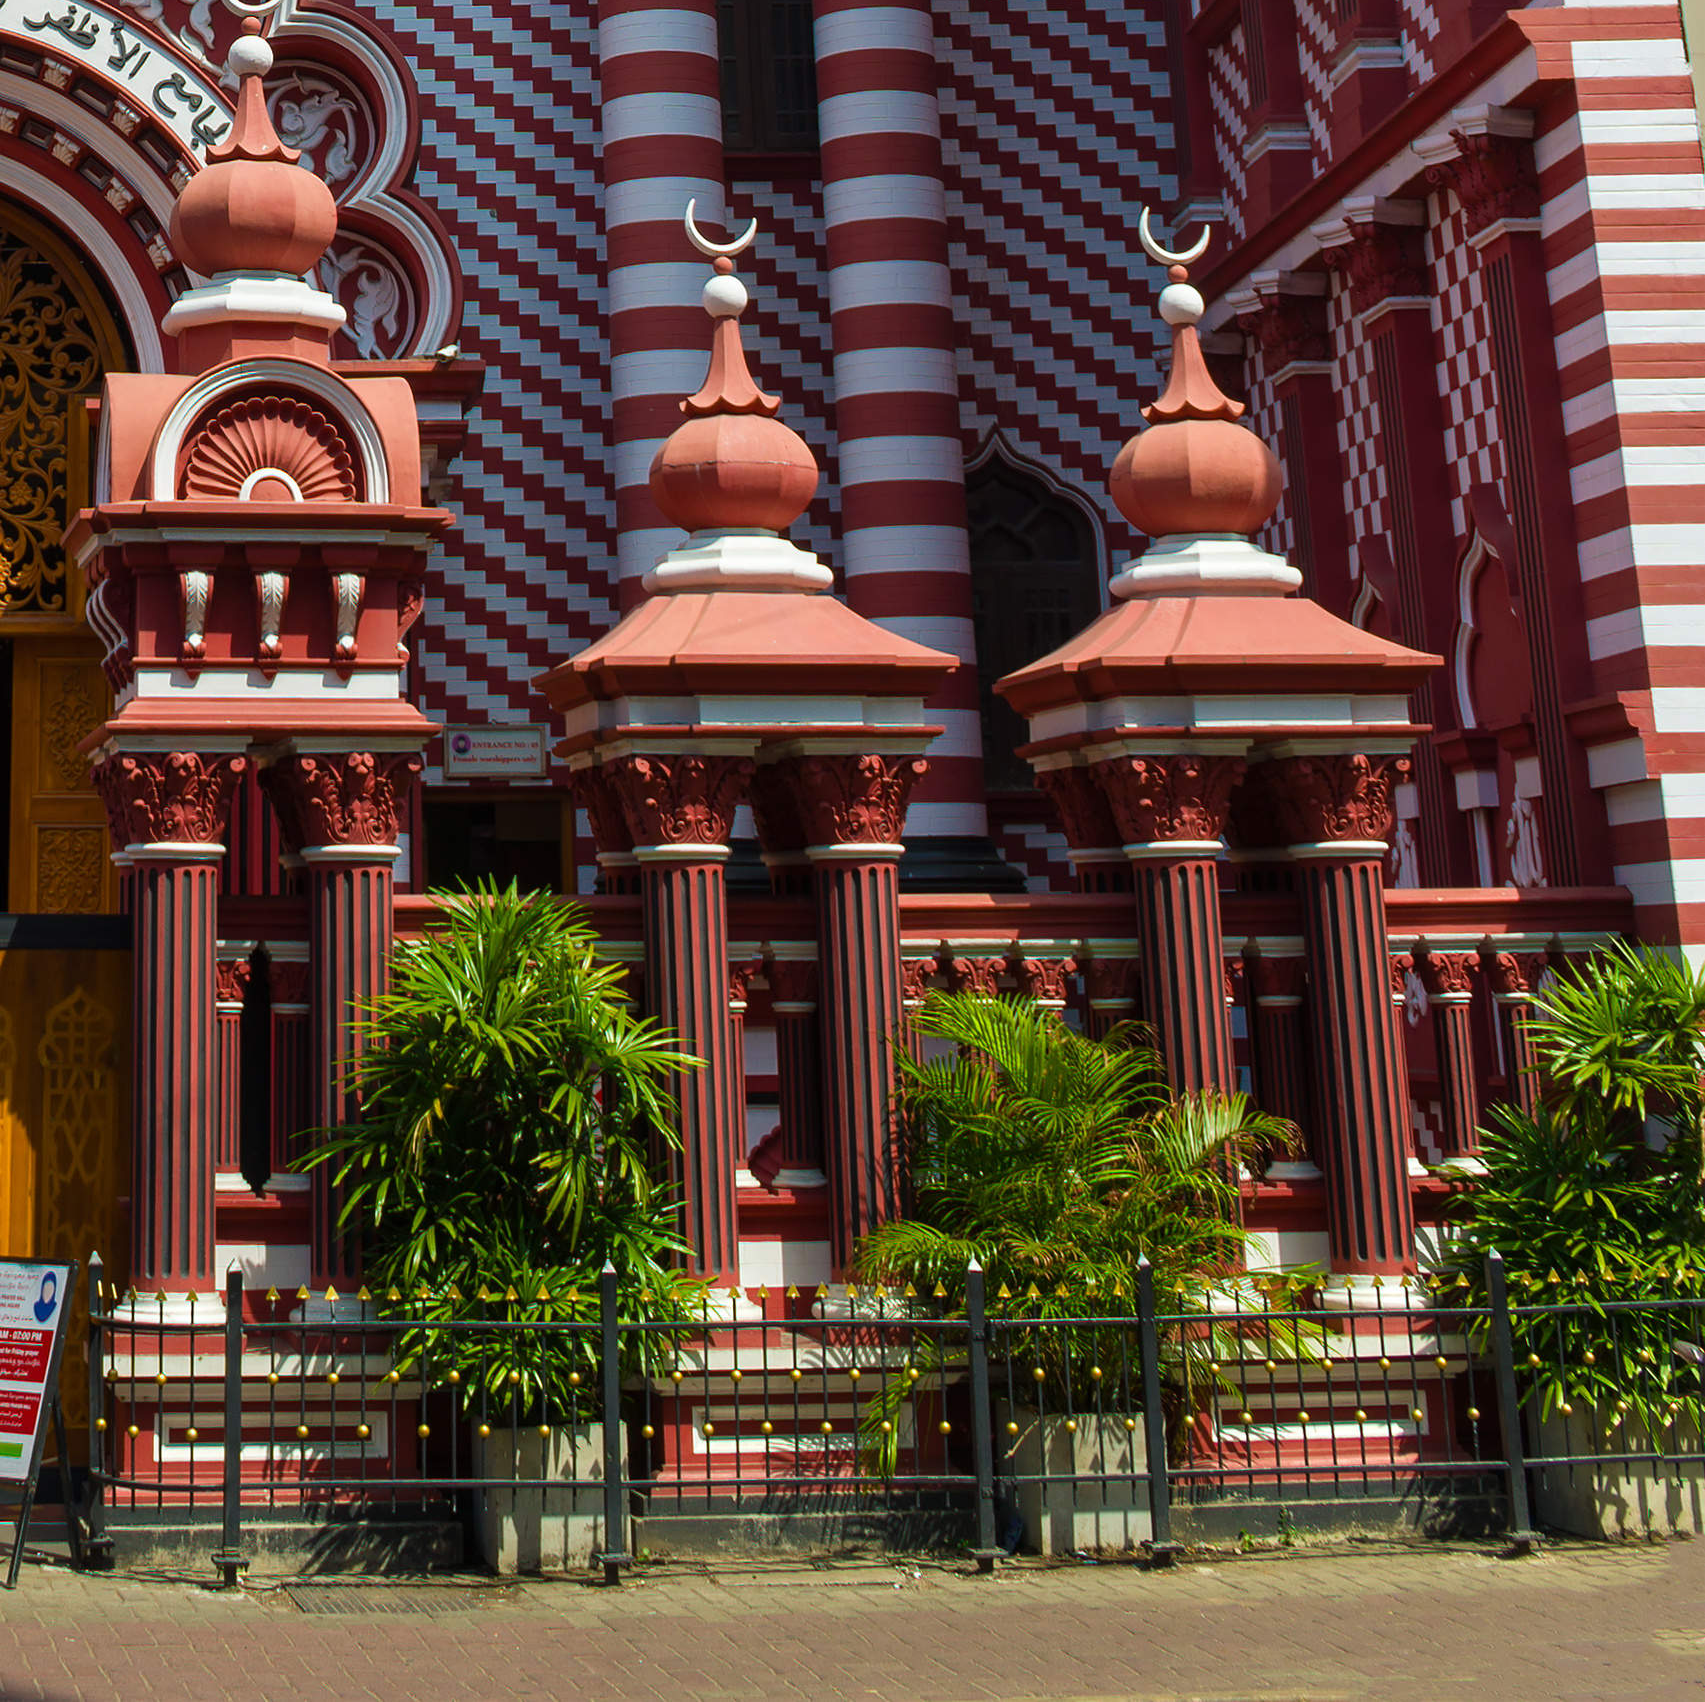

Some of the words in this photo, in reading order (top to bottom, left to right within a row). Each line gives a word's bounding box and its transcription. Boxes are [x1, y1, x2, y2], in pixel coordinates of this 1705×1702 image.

[472, 741, 512, 749] ENTRANCE
[514, 741, 526, 749] NO
[452, 754, 478, 763] Female
[479, 754, 521, 764] worshippers
[522, 754, 538, 764] only
[12, 1331, 31, 1341] 07:00
[31, 1331, 42, 1341] PM
